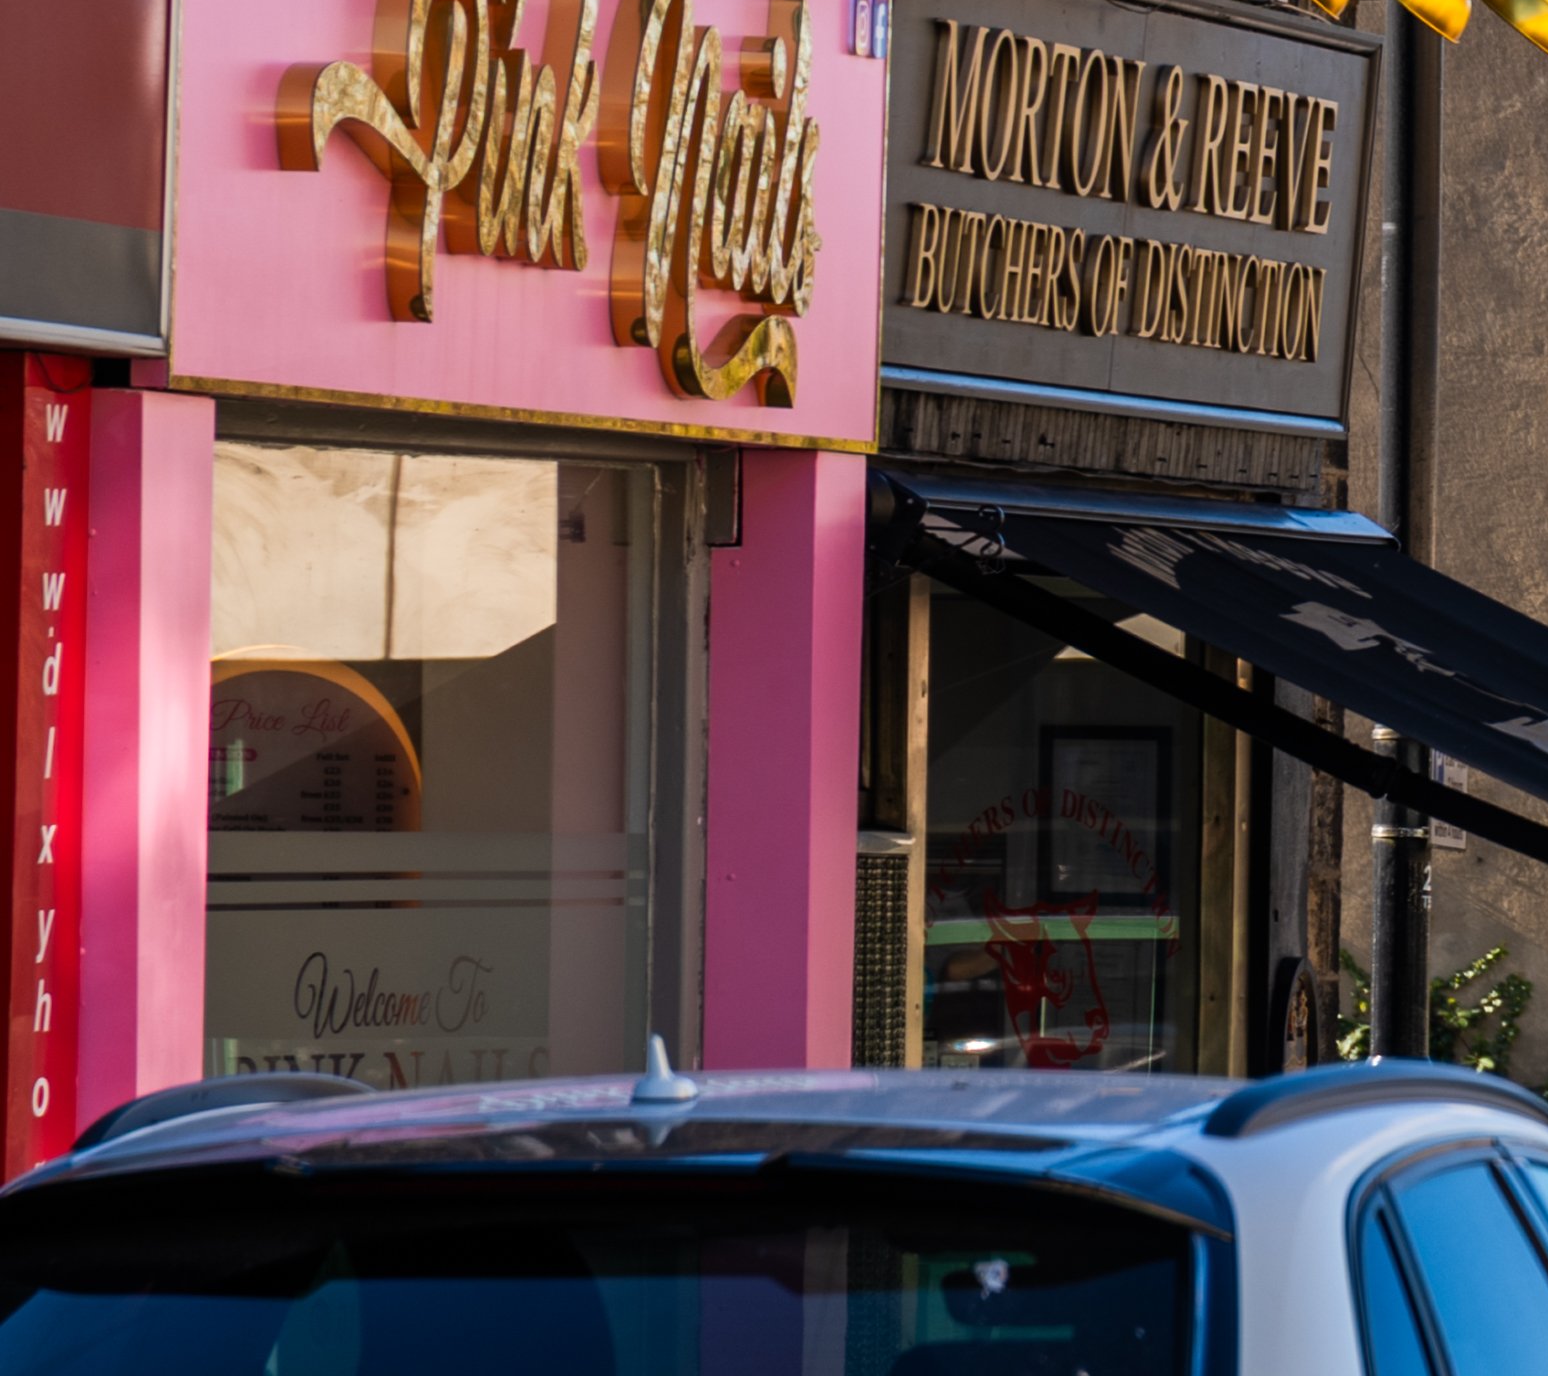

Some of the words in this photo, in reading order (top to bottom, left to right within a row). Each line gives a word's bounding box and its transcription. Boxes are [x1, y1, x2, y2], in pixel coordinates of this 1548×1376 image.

[928, 19, 1147, 203] MORTON
[1148, 64, 1189, 212] &
[1194, 73, 1340, 235] REEVE
[912, 203, 1085, 332] BUTCHERS
[1091, 234, 1133, 337] OF
[1138, 239, 1328, 363] DISTINCTION
[32, 404, 68, 1169] www.dlxyho
[211, 699, 285, 732] Price
[292, 698, 350, 742] List
[294, 951, 432, 1040] Welcome
[434, 954, 494, 1034] To
